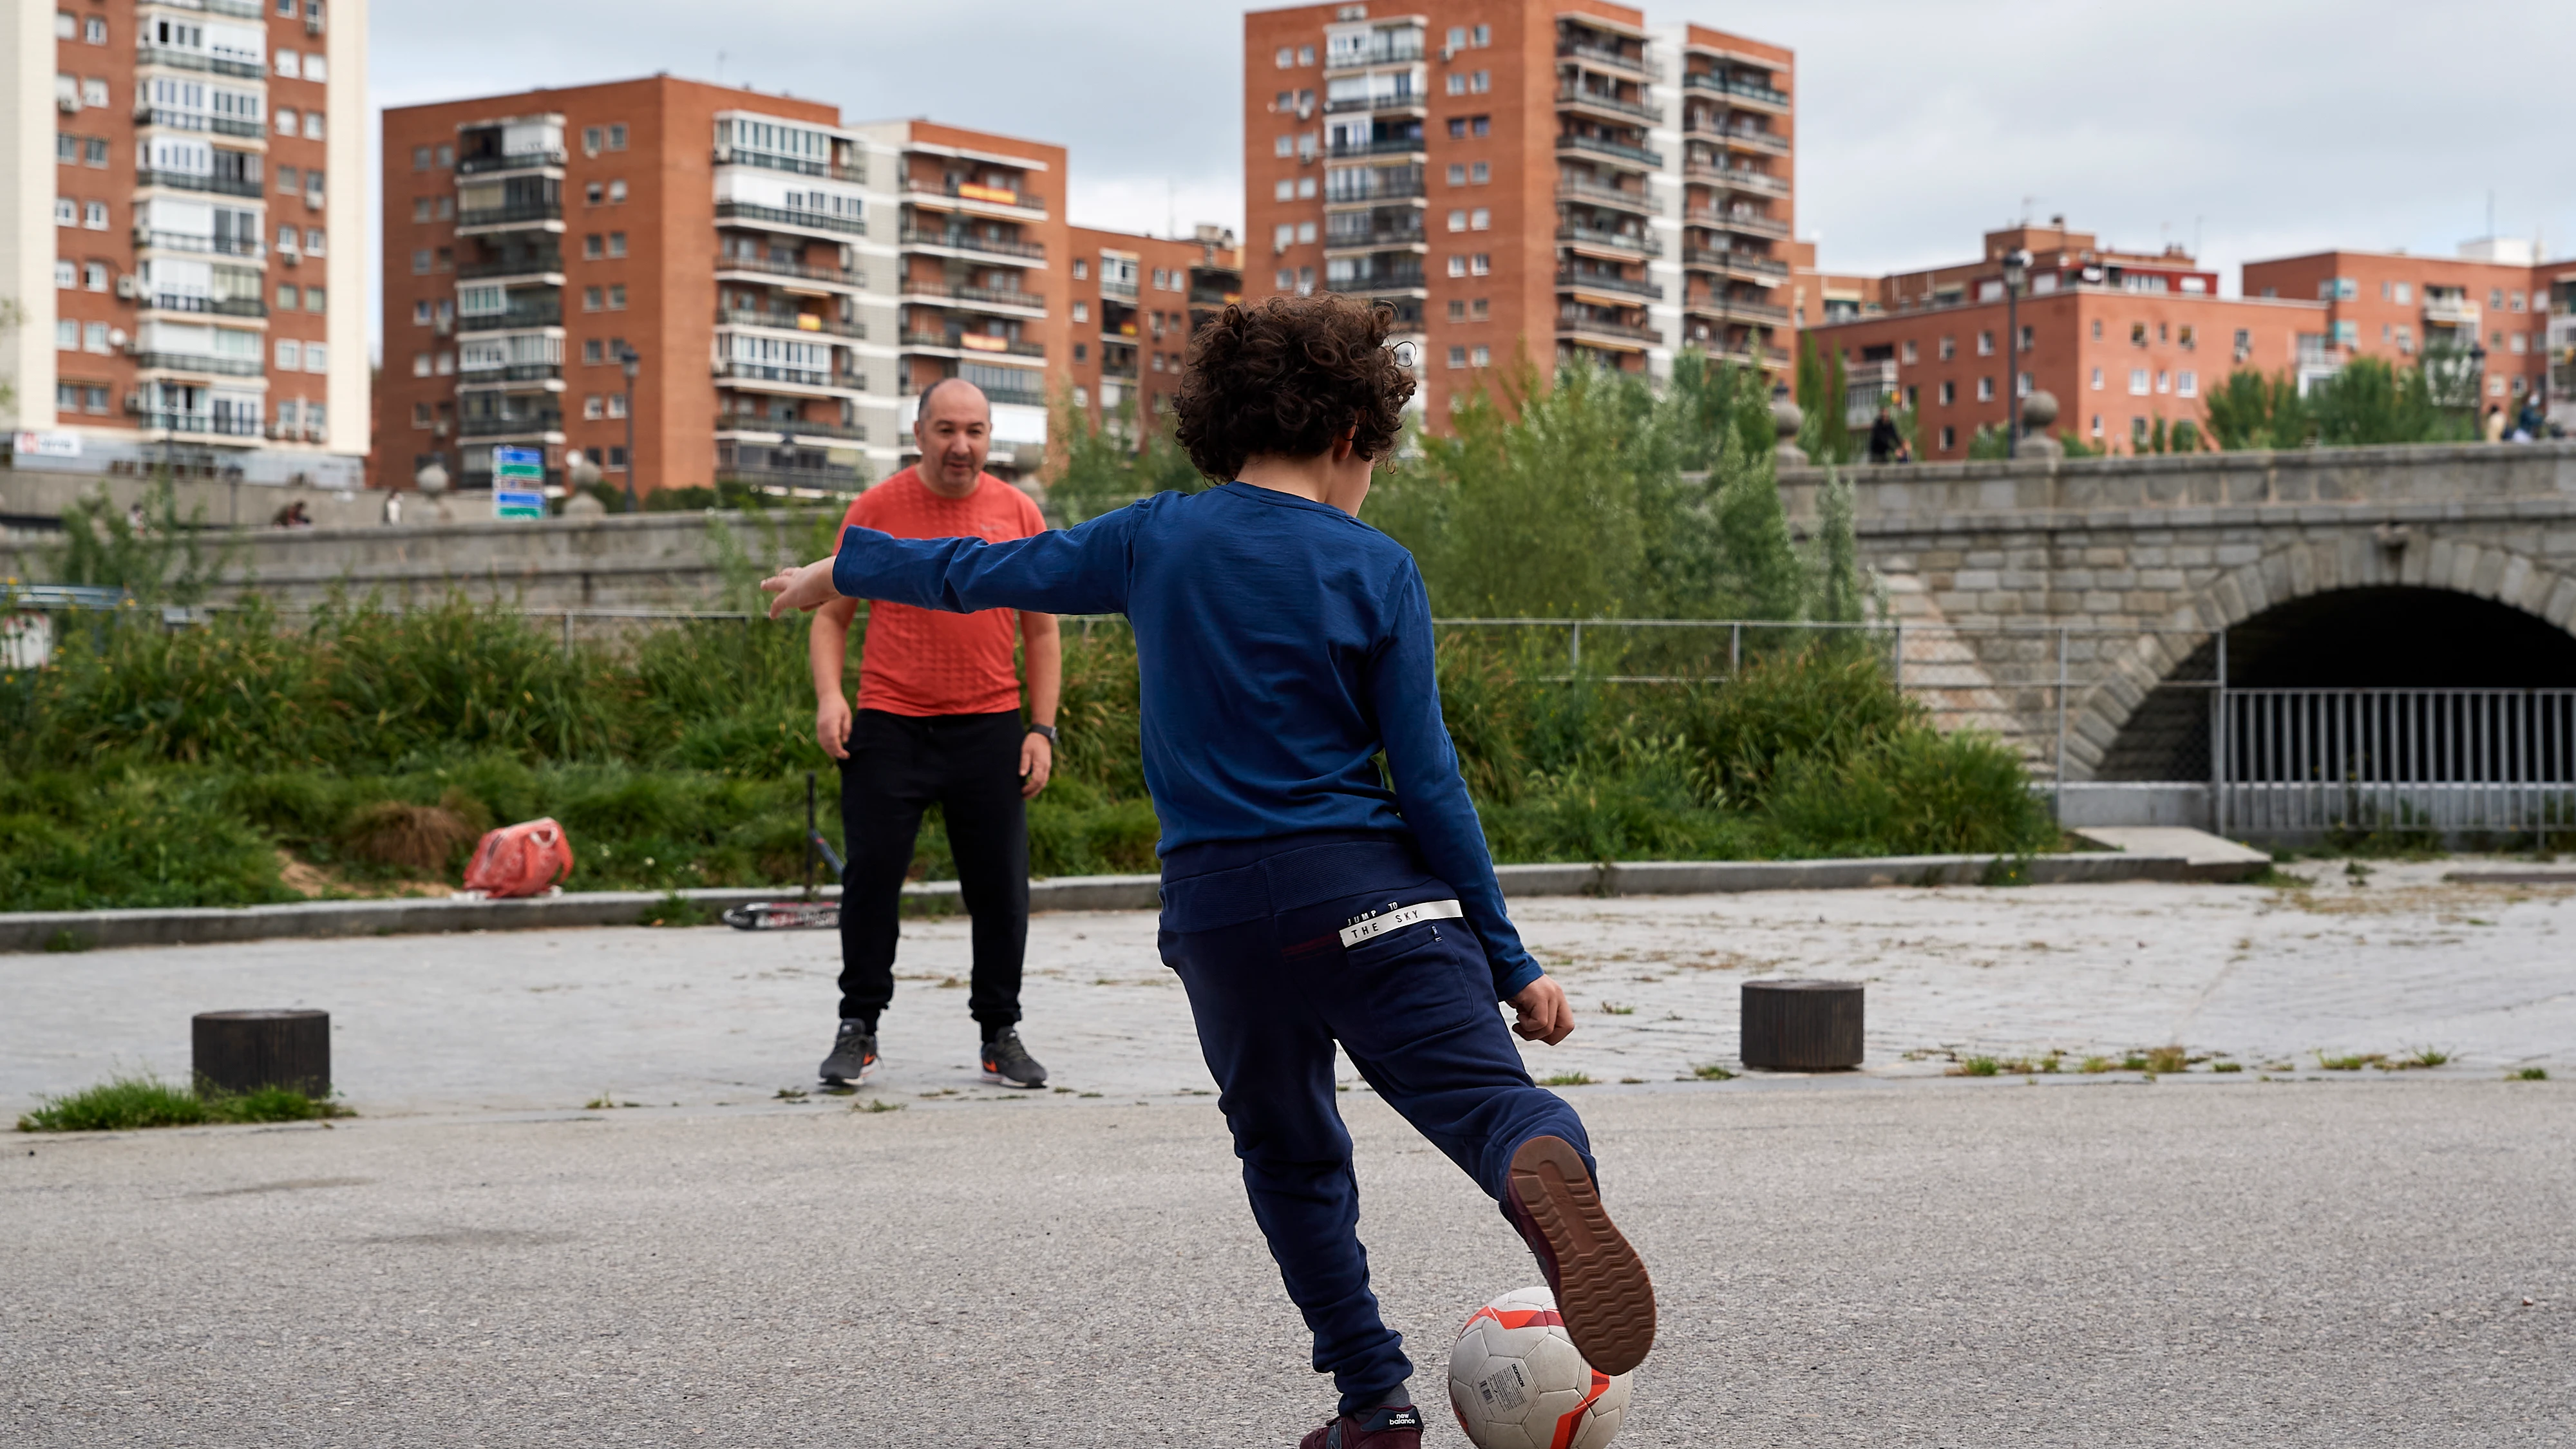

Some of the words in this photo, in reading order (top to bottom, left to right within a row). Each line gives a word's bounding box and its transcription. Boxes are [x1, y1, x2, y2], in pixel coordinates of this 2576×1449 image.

[1347, 910, 1376, 926] JUMP
[1388, 902, 1398, 911] TO
[1350, 923, 1379, 938] THE
[1395, 910, 1418, 923] SKY
